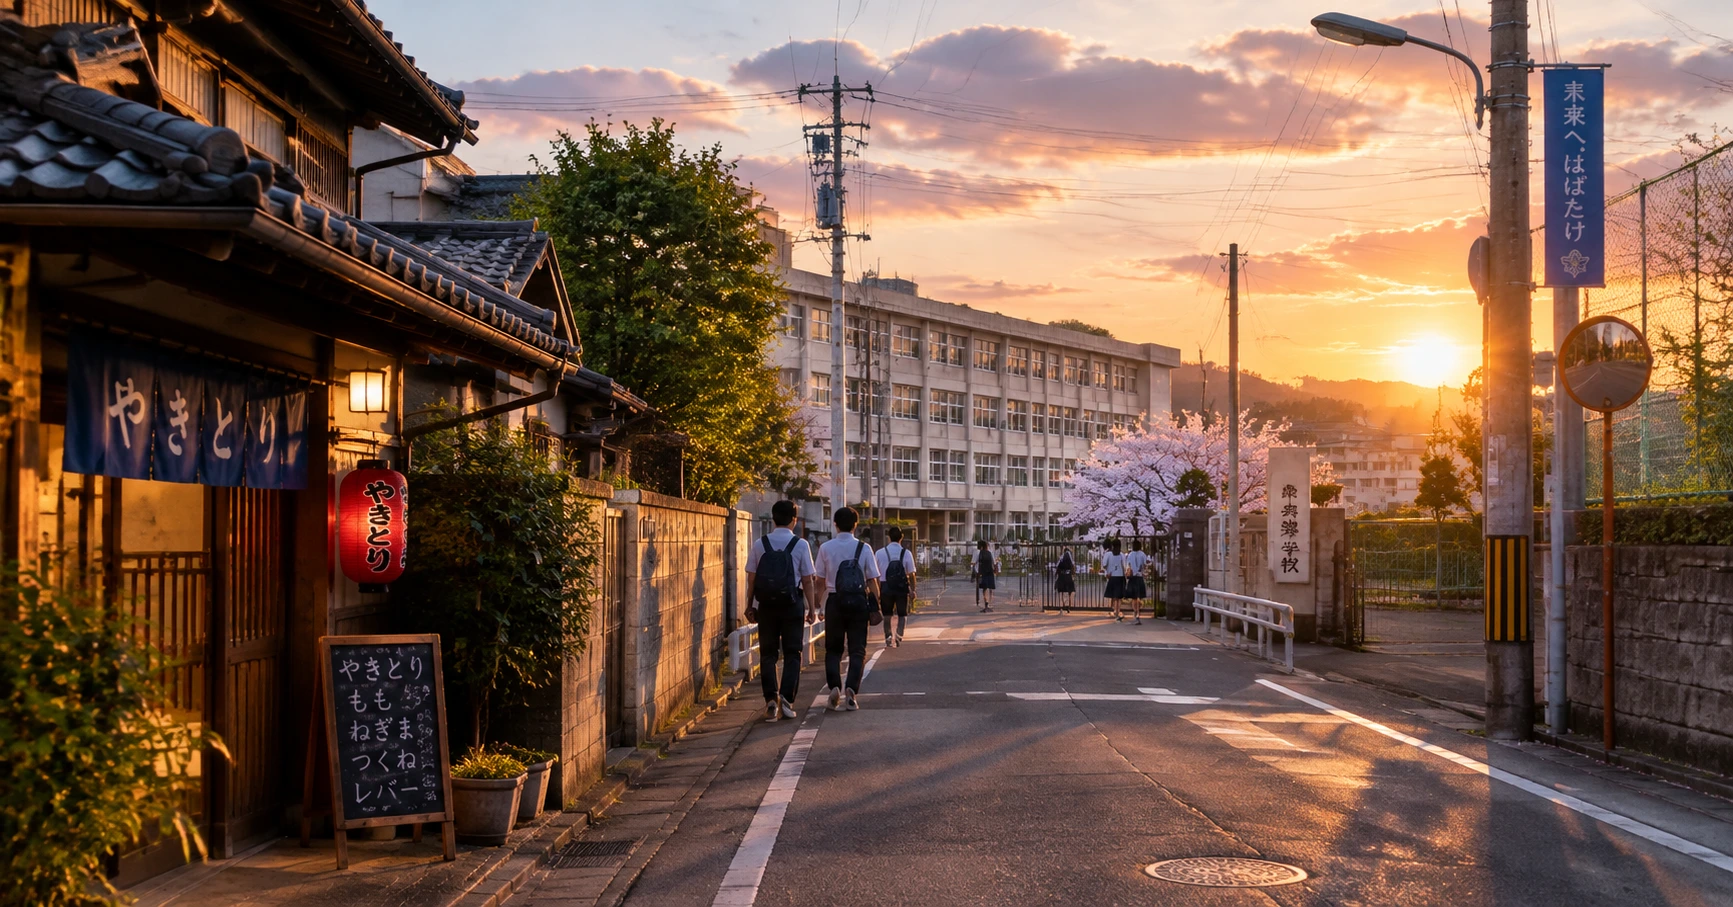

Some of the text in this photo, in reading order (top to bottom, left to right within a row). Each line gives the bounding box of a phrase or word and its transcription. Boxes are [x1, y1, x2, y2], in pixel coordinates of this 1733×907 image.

[109, 377, 276, 465] やきとり
[363, 480, 395, 573] やきとり
[339, 656, 423, 681] やきとり
[348, 688, 392, 713] もも
[349, 716, 414, 742] ねぎま
[352, 748, 416, 773] つくね
[354, 779, 419, 804] レバー
